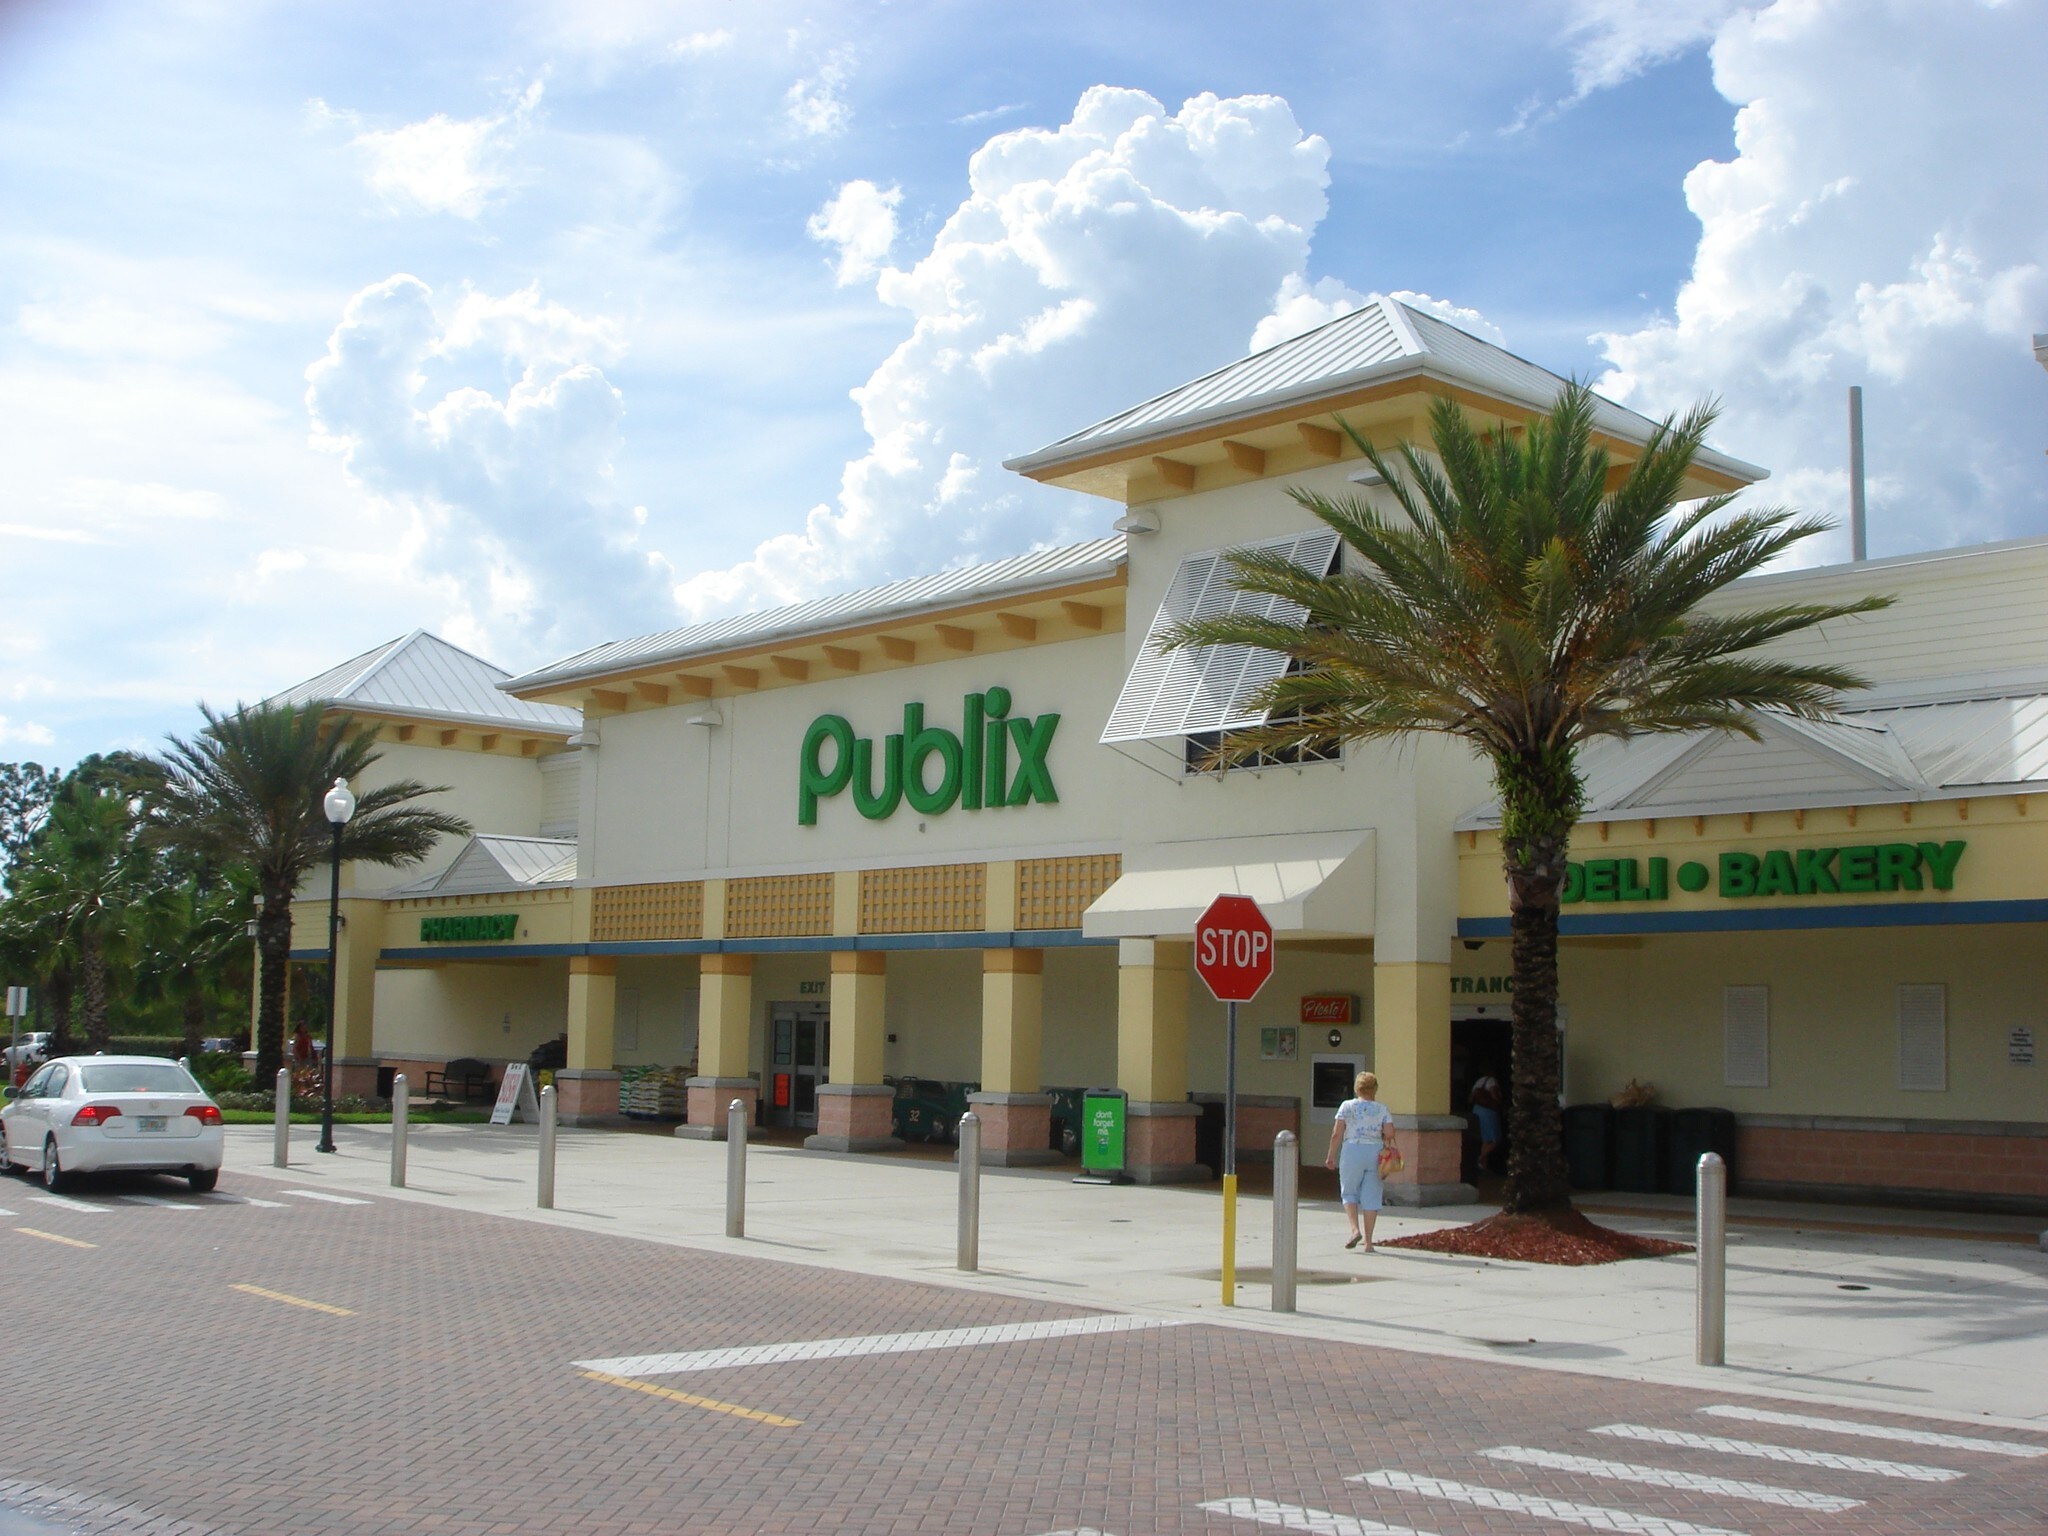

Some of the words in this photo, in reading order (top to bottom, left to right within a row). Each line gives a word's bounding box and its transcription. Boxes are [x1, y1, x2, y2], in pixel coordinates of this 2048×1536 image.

[798, 686, 1061, 826] Publix
[1719, 841, 1967, 898] BAKERY
[420, 914, 520, 942] PHARMACY
[1200, 927, 1268, 968] STOP
[800, 981, 826, 994] EXIT
[909, 1109, 920, 1123] 32
[1093, 1118, 1114, 1129] forget
